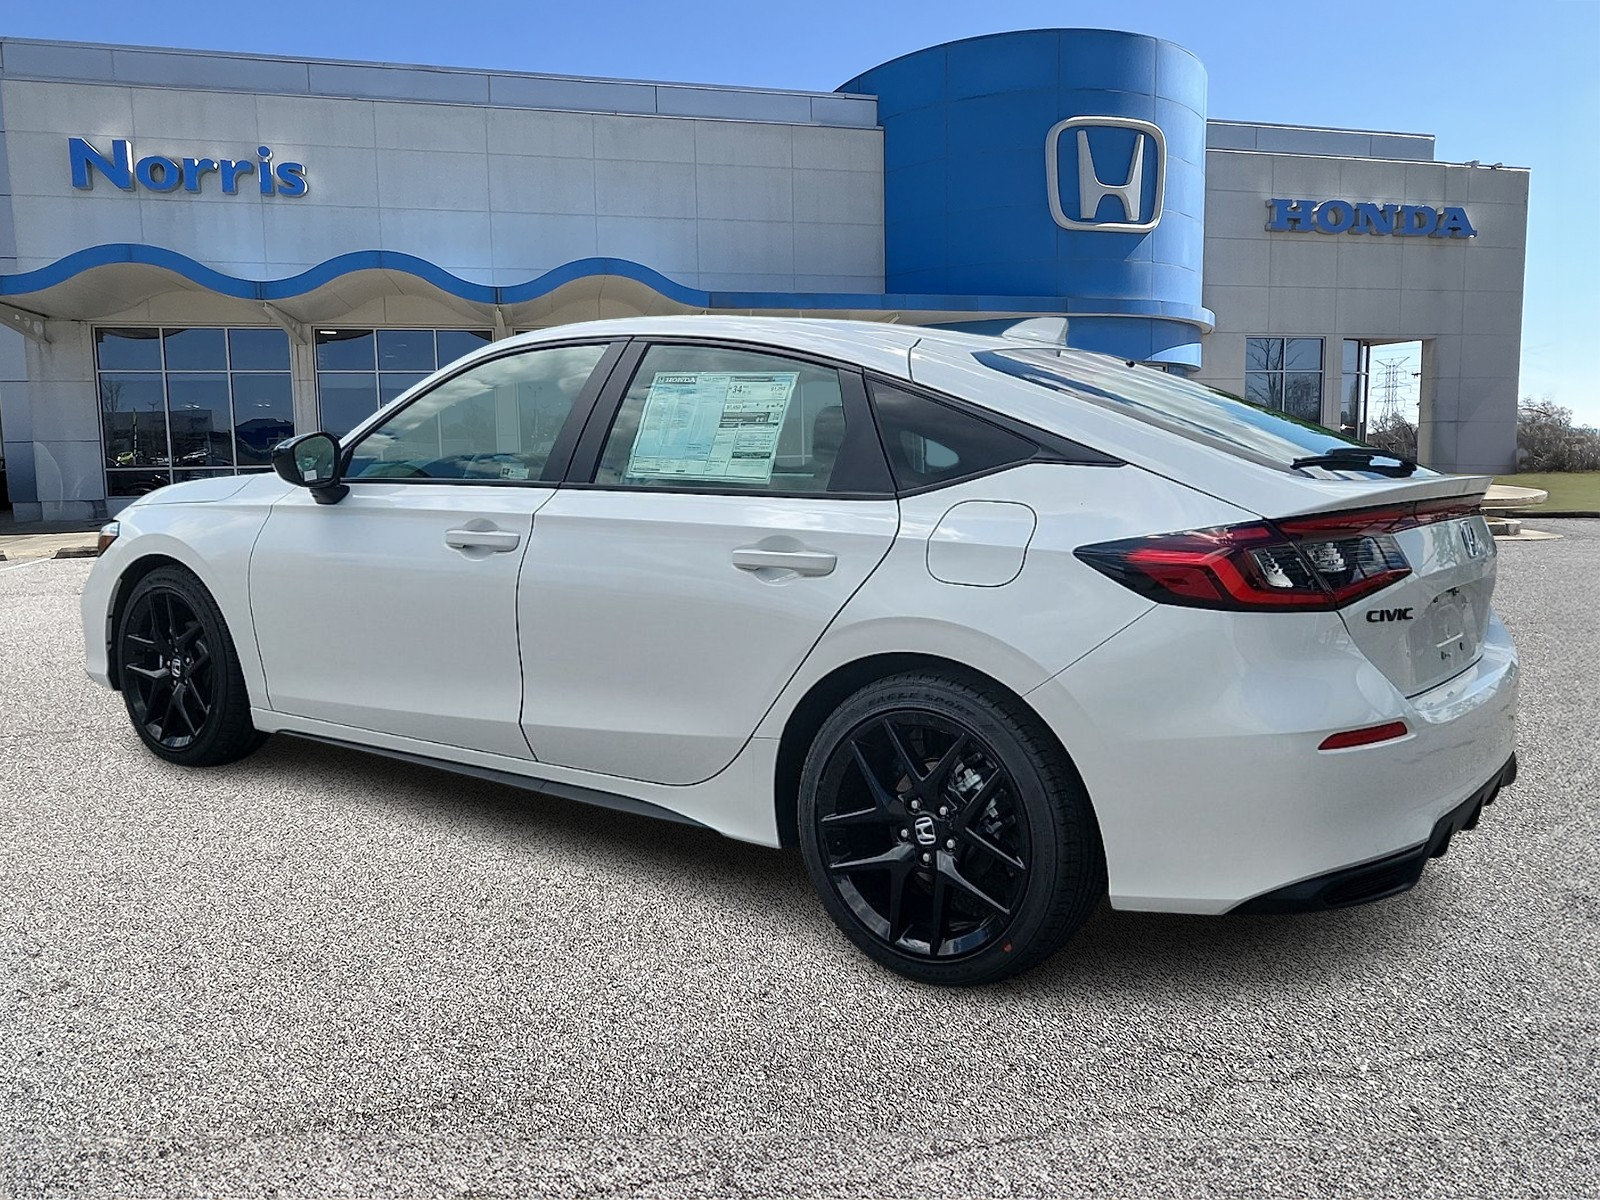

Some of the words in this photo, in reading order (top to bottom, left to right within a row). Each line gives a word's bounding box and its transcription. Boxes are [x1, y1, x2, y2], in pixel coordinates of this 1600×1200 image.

[68, 137, 309, 197] Norris
[1266, 198, 1478, 239] HONDA
[1366, 606, 1414, 622] CIVIC
